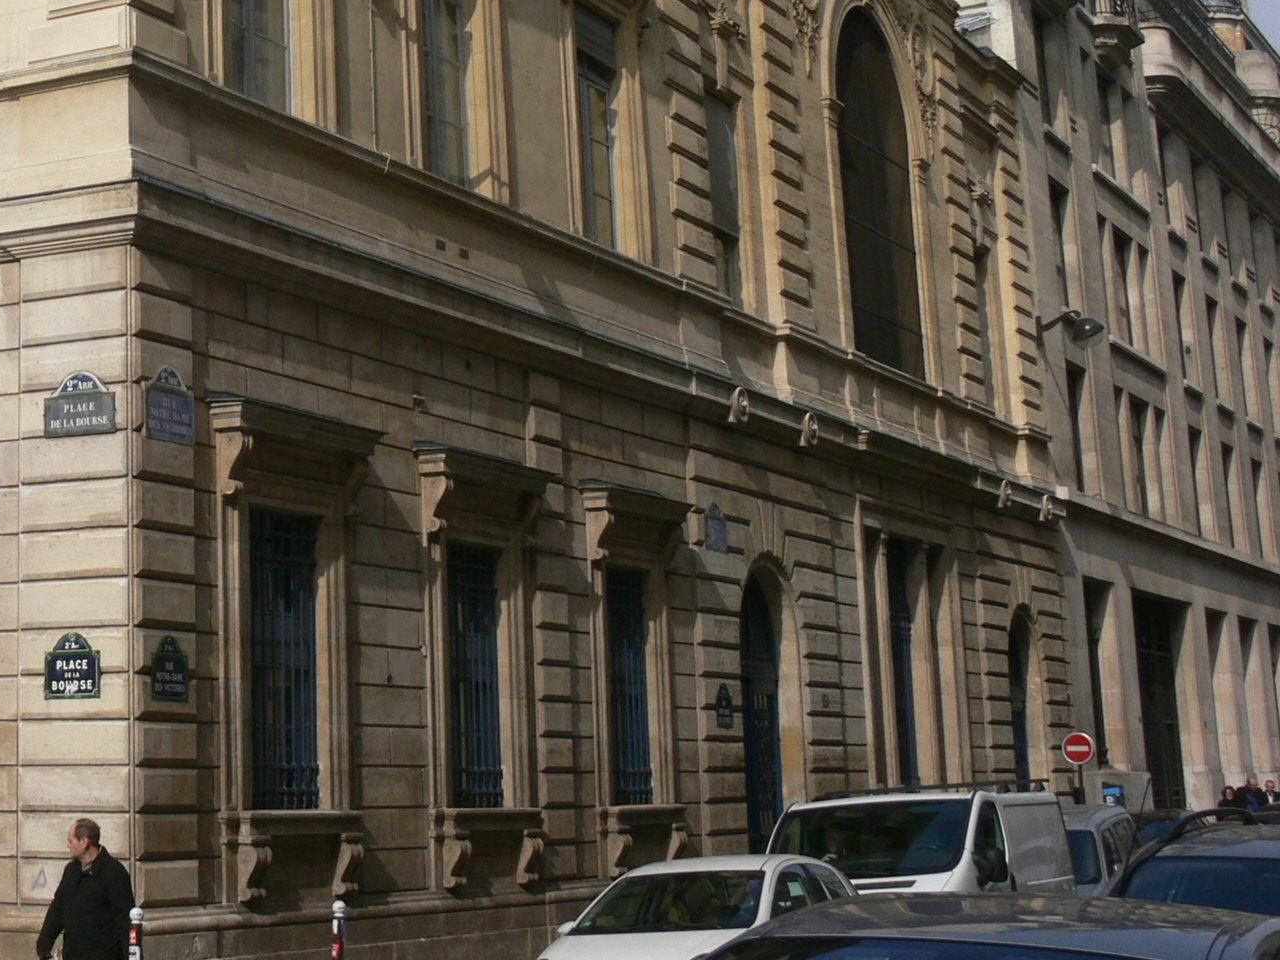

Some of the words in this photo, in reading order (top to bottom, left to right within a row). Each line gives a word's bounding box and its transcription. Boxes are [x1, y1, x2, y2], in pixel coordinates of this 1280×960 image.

[63, 401, 95, 413] PLACE
[50, 419, 62, 428] DE
[63, 418, 75, 427] LA
[76, 415, 109, 426] BOURSE
[56, 659, 88, 670] PLACE
[51, 680, 93, 691] BOURSE
